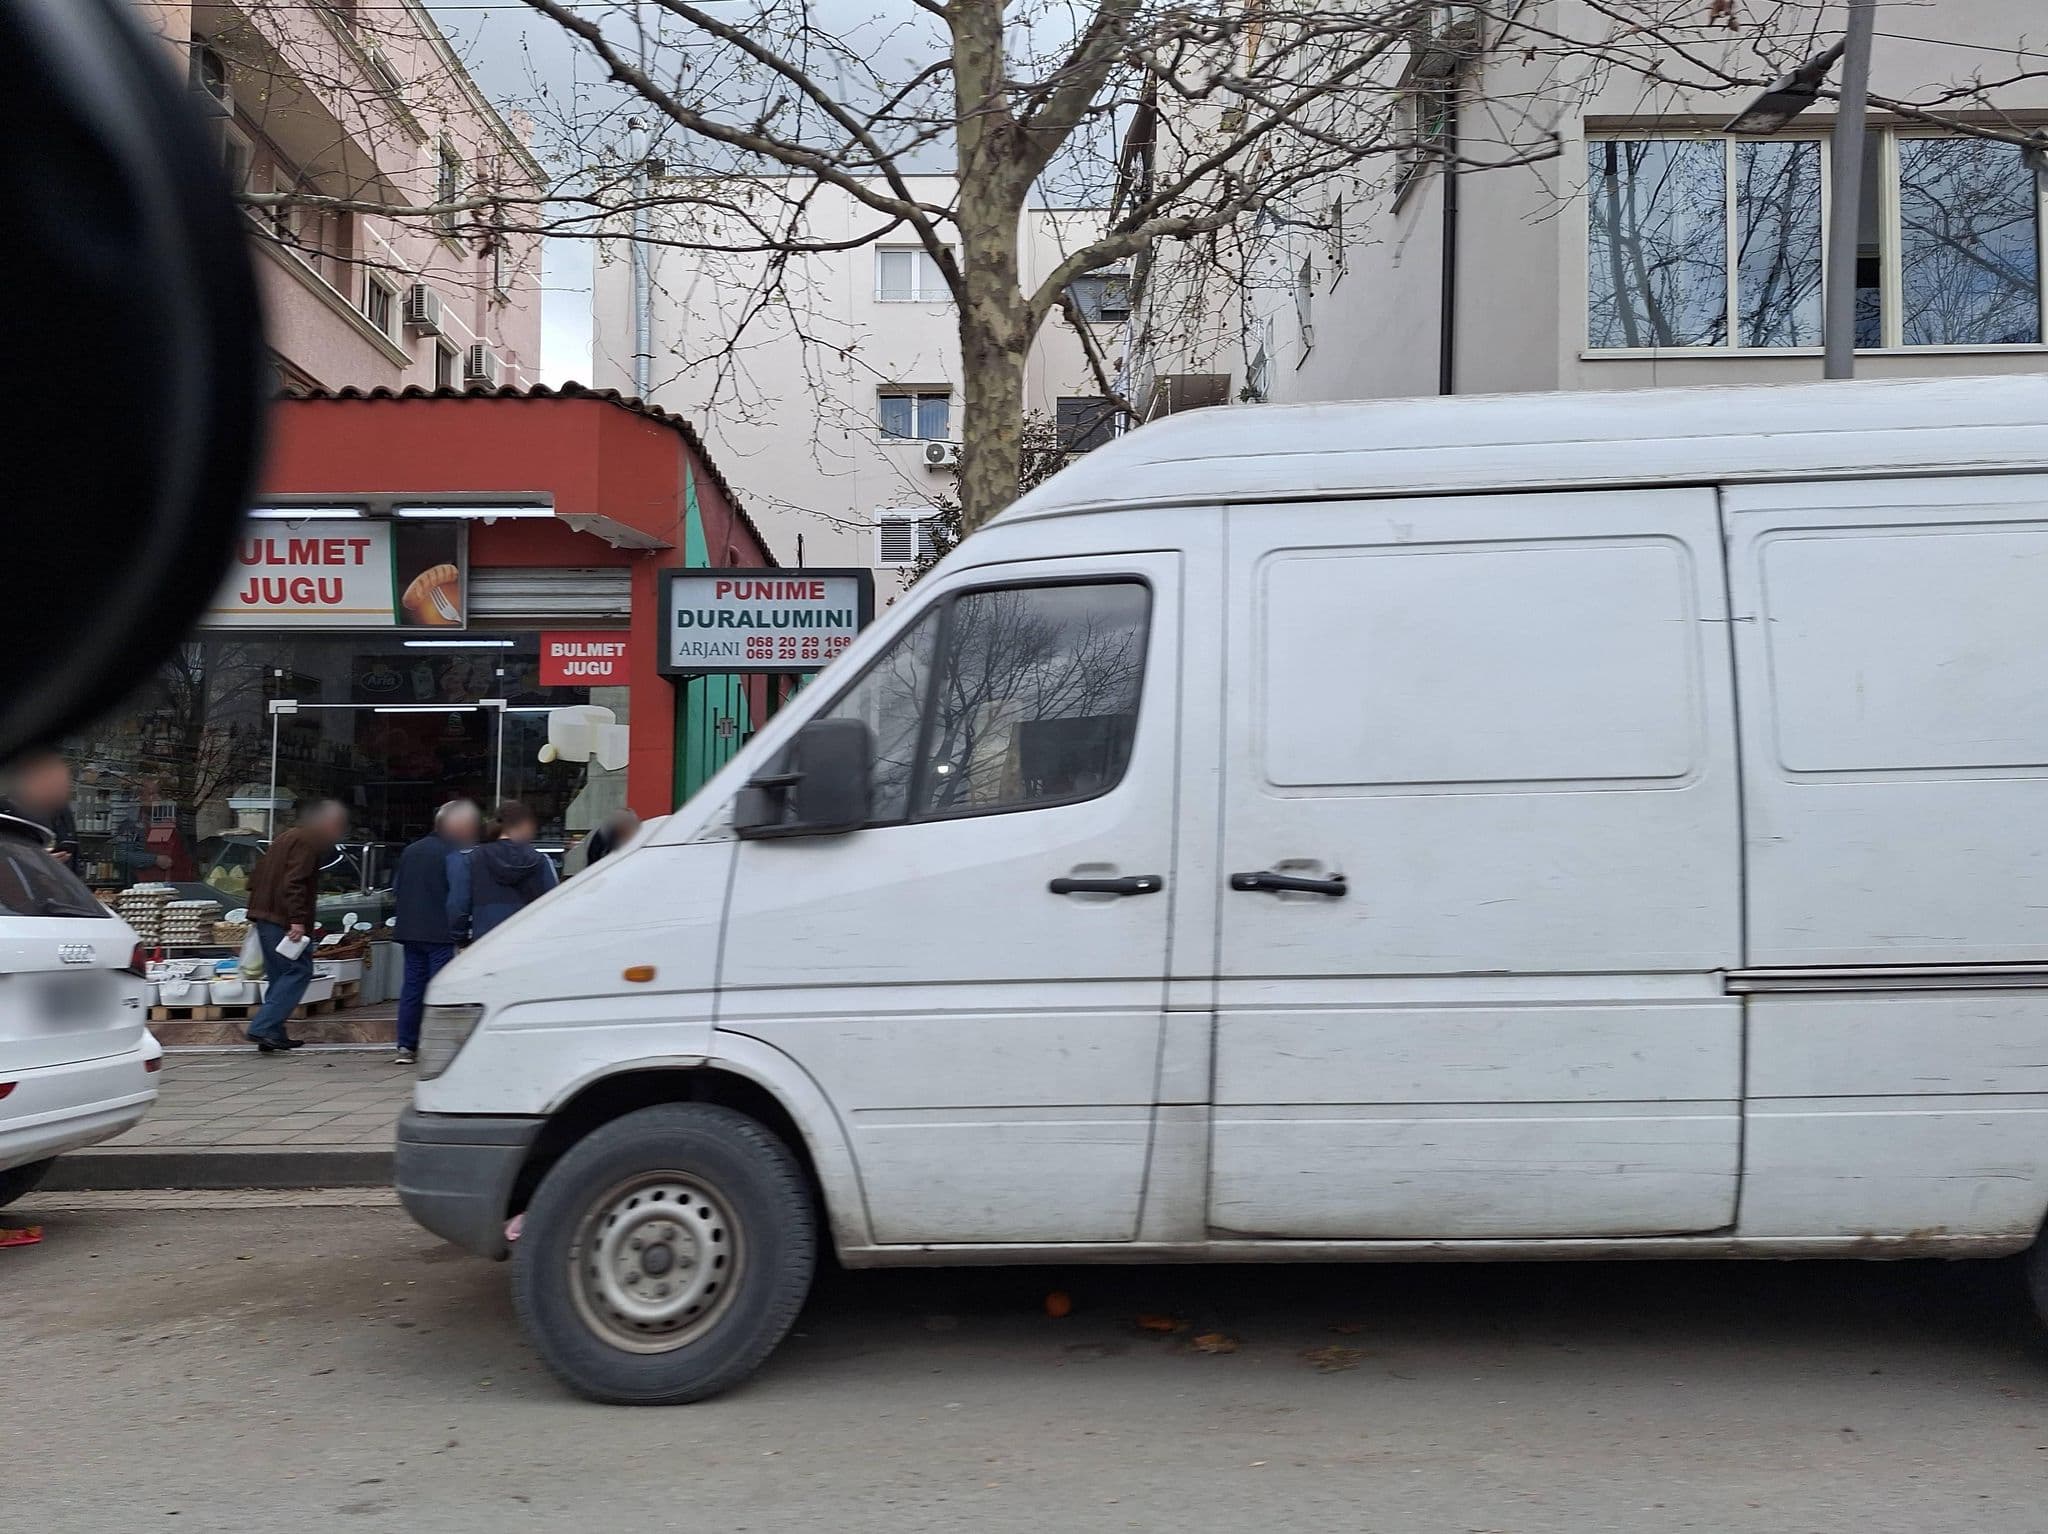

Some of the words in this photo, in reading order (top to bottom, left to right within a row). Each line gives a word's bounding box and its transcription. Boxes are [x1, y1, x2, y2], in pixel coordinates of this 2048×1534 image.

[236, 538, 371, 566] ULMET
[240, 577, 344, 605] JUGU
[715, 581, 826, 600] PUNIME
[677, 609, 853, 629] DURALUMINI
[550, 642, 626, 657] BULMET
[679, 642, 740, 659] ARJANI
[746, 636, 773, 648] 068
[778, 636, 797, 648] 20
[801, 636, 819, 648] 29
[824, 636, 851, 648] 168
[746, 648, 773, 660] 069
[779, 648, 796, 660] 29
[801, 648, 819, 660] 89
[823, 648, 842, 660] 43
[563, 661, 613, 676] JUGU
